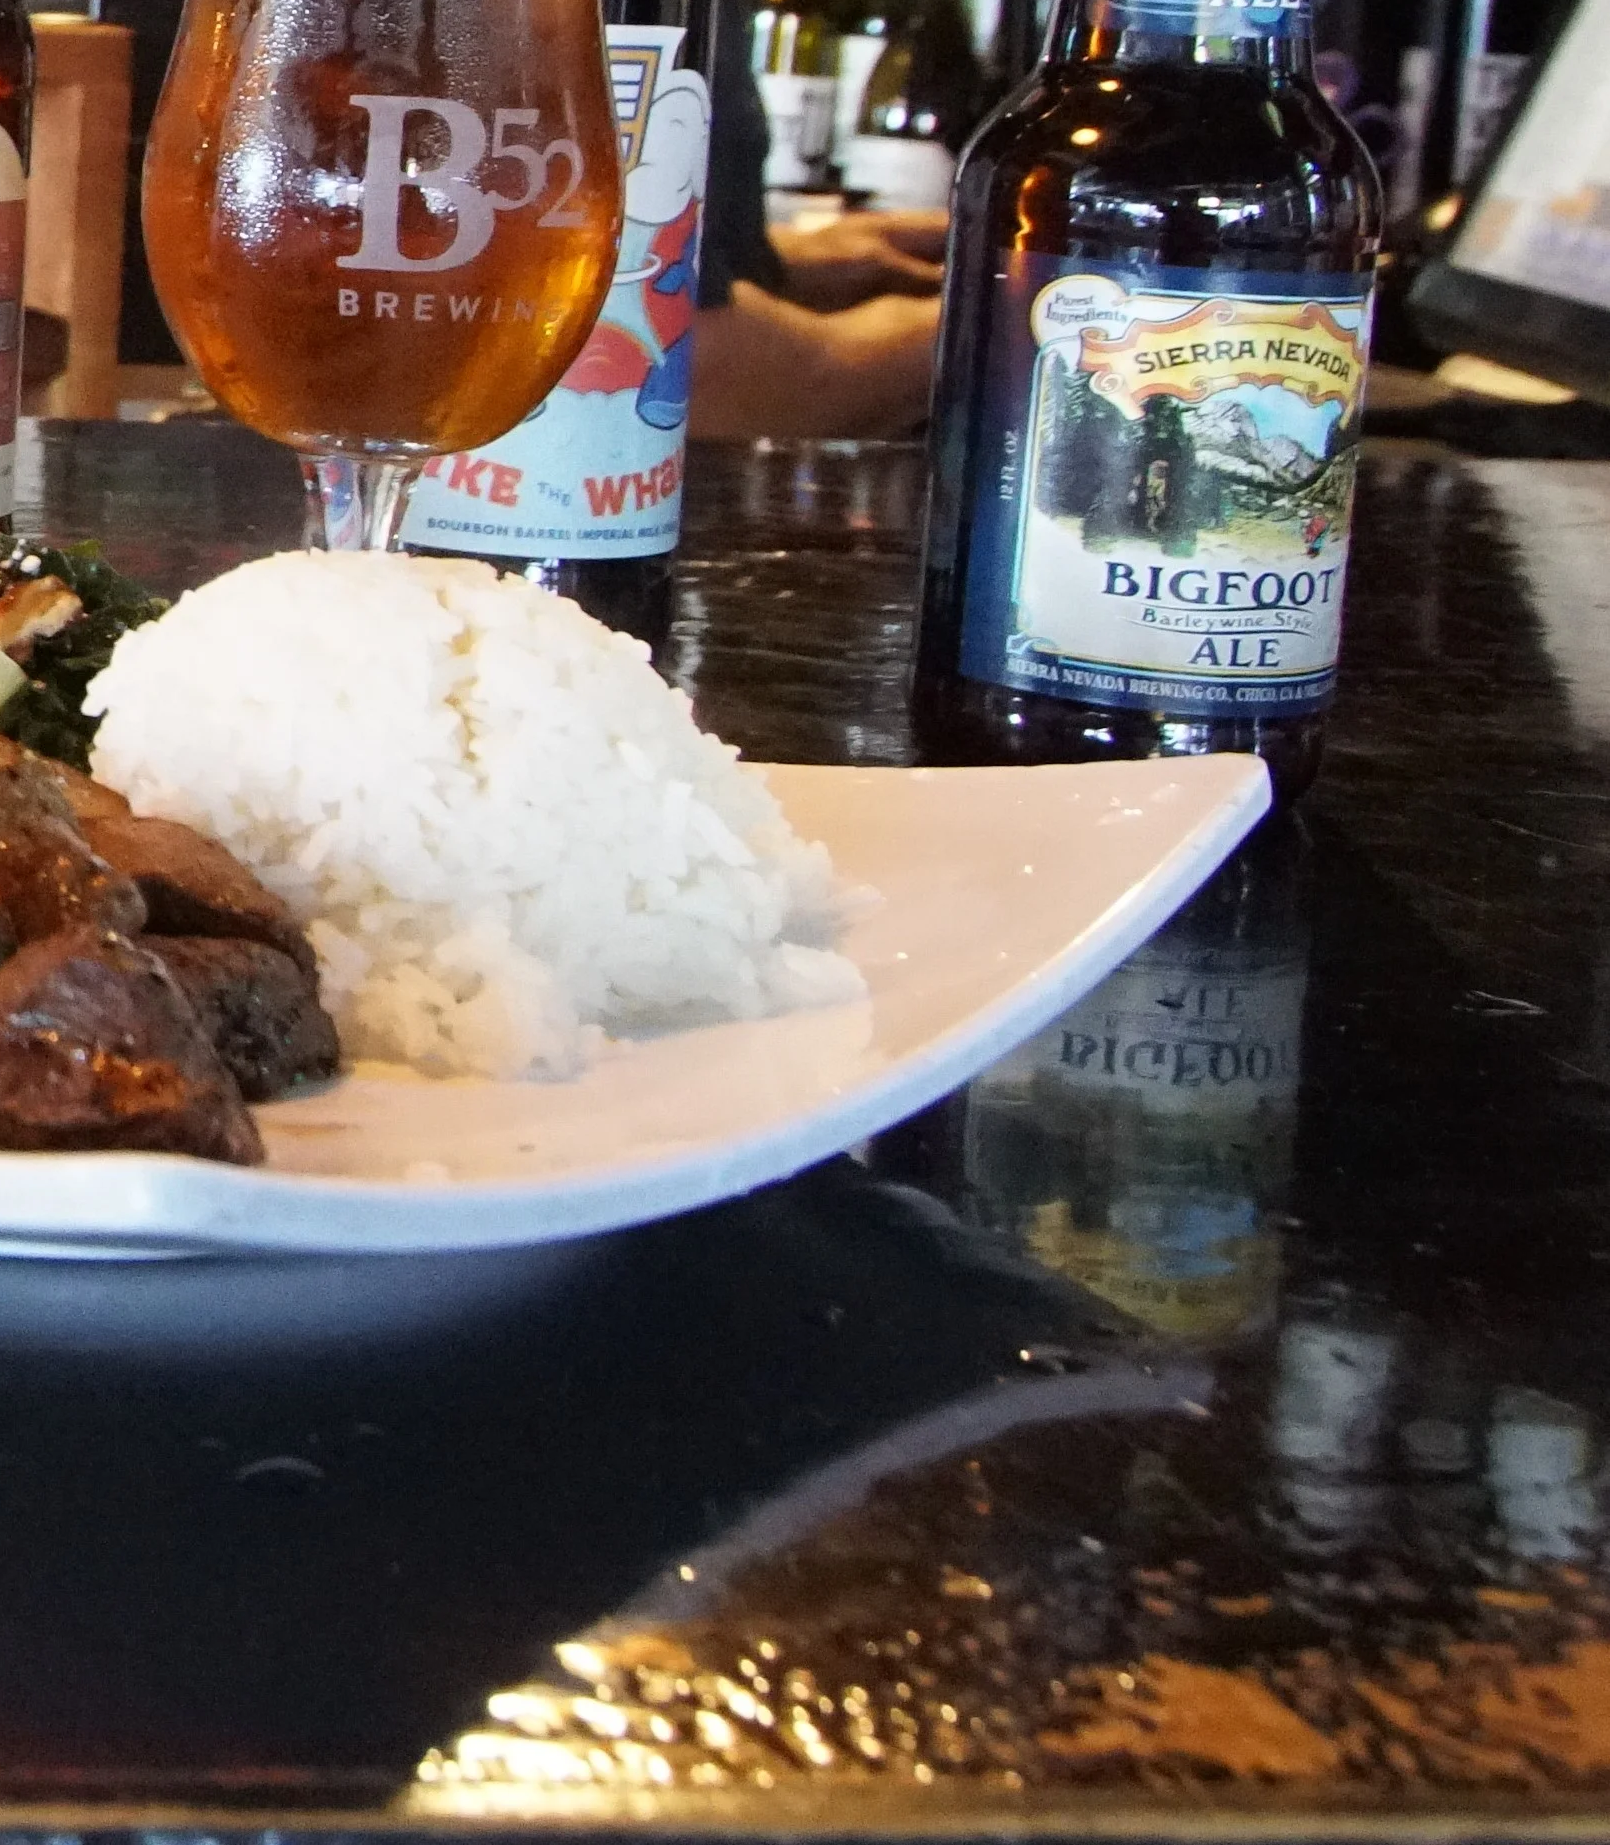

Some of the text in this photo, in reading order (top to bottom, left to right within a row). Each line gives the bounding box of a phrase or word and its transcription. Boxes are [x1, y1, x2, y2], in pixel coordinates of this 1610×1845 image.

[1134, 336, 1351, 384] SIERRA NEVADA
[426, 517, 509, 538] BOURBON
[514, 526, 571, 541] BARREL
[1100, 560, 1337, 607] BIGFOOT
[1141, 607, 1265, 632] Barleywine
[1186, 636, 1282, 668] ALE
[1062, 668, 1125, 693] NEVADA
[1128, 678, 1203, 701] BREWING
